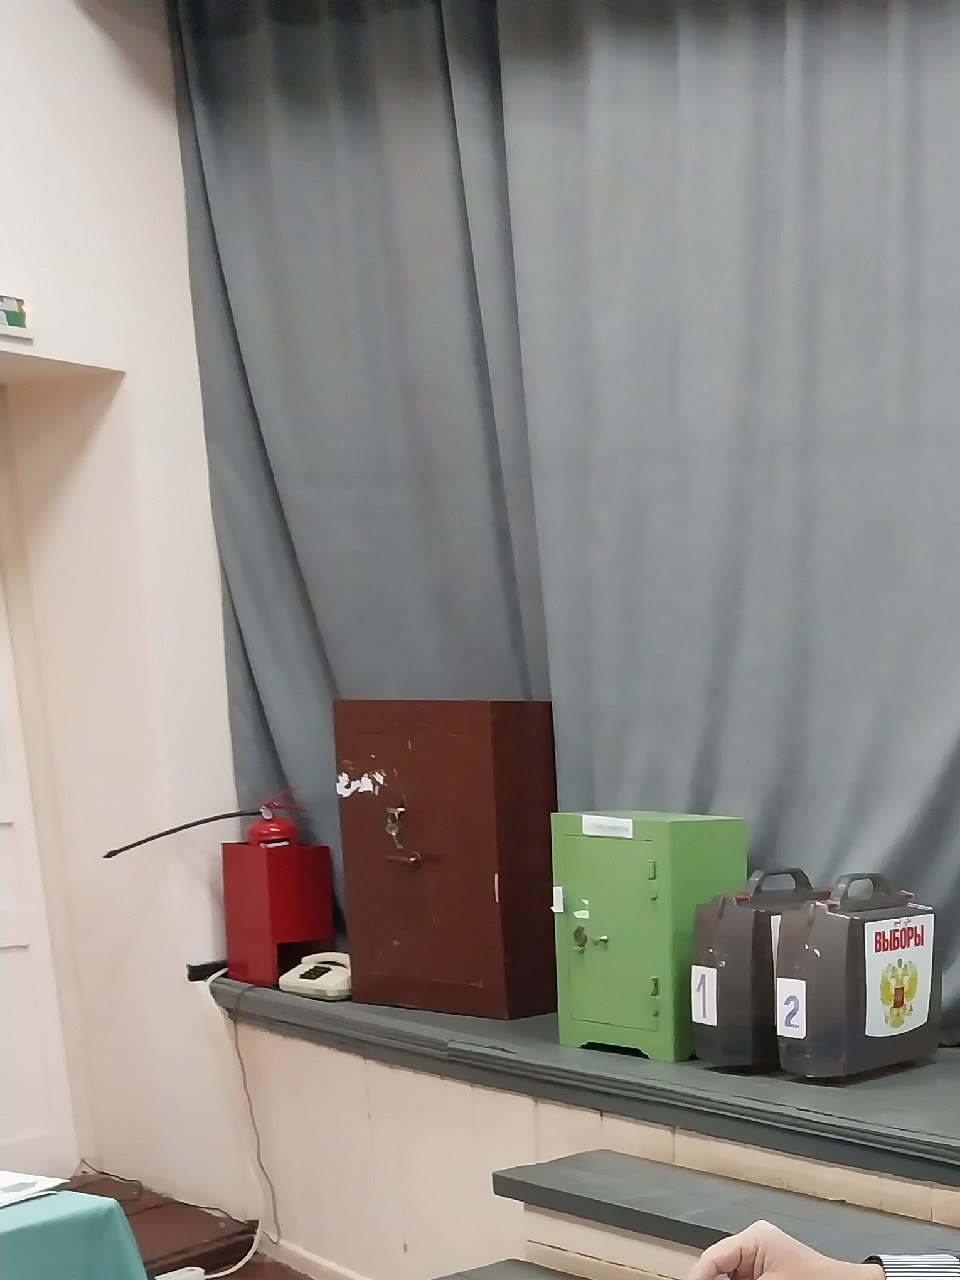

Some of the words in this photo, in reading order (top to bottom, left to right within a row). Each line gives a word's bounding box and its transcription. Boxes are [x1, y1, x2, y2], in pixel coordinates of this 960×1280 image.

[875, 924, 924, 953] ВЫБОРЫ
[696, 974, 707, 1019] 1
[784, 995, 800, 1029] 2
